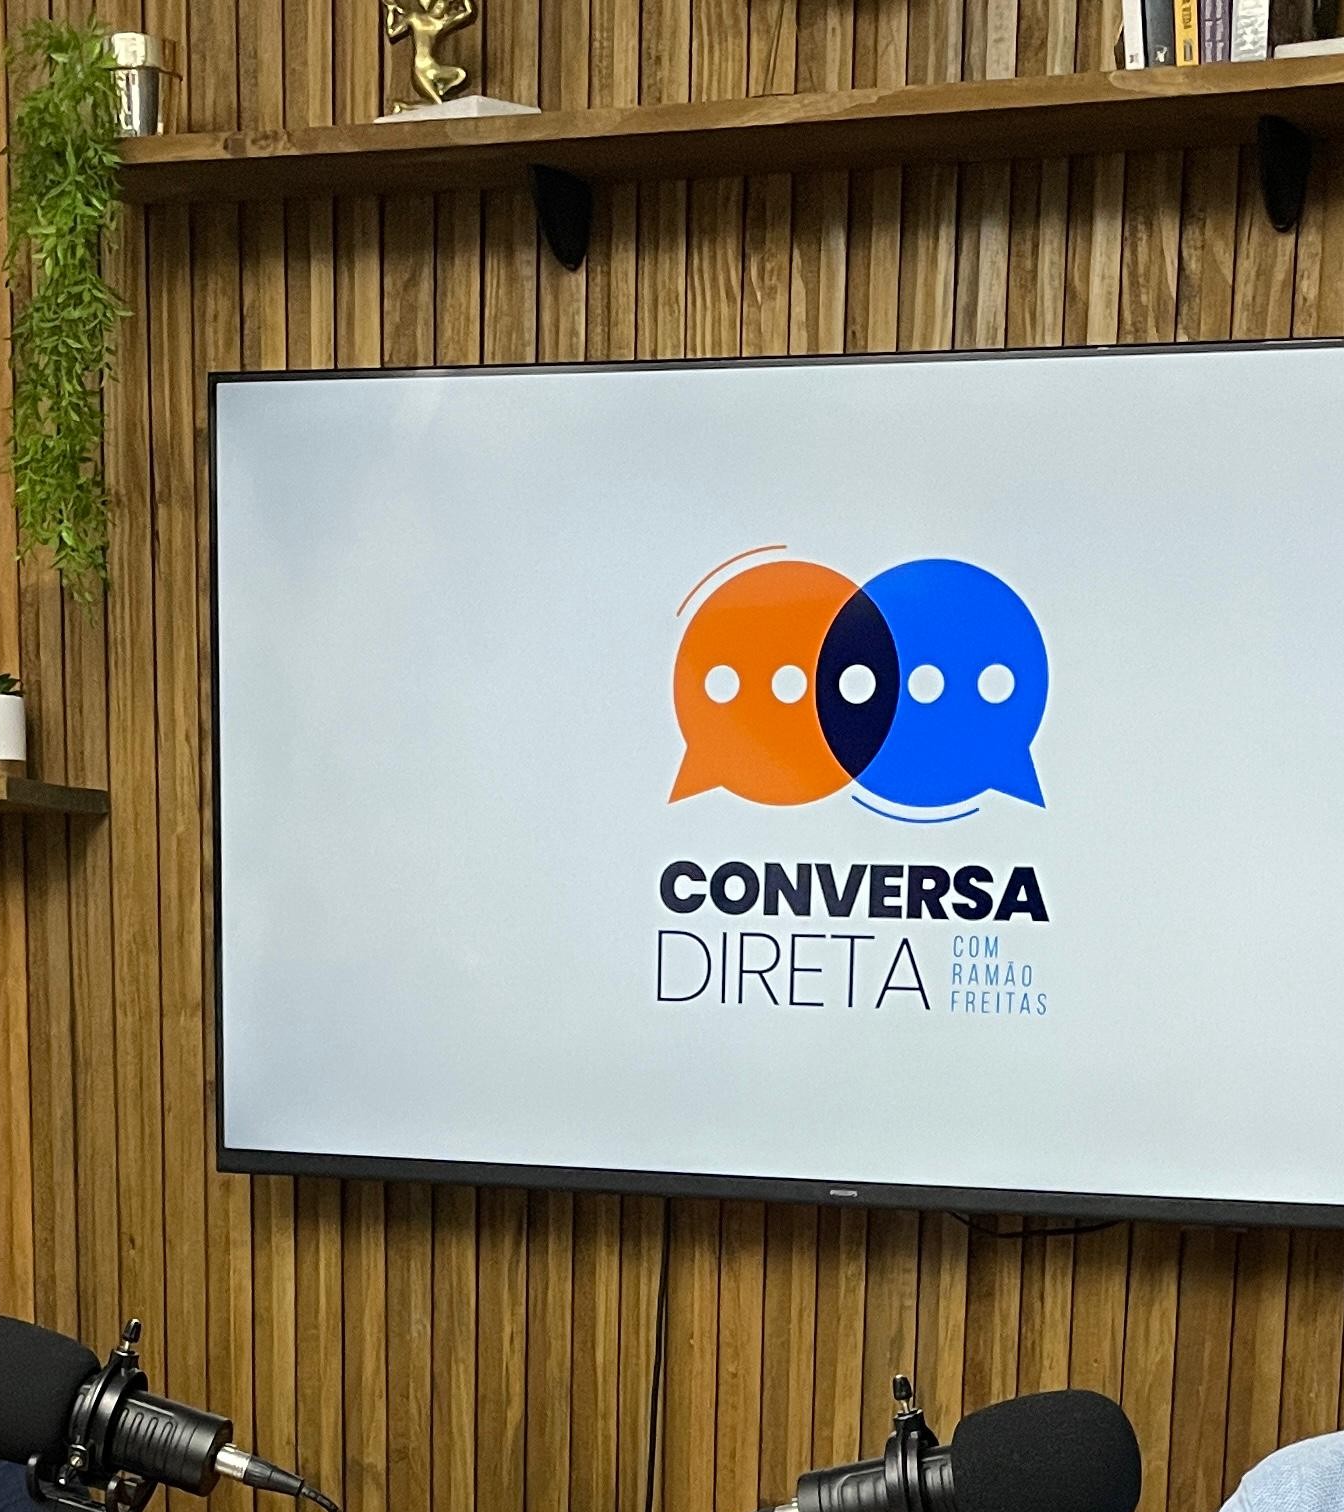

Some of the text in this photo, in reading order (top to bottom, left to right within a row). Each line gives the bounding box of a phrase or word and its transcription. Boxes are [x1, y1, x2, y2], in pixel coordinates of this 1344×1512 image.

[659, 860, 1050, 923] CONVERSA
[953, 935, 1000, 959] COM
[656, 930, 931, 1011] DIRETA
[951, 961, 1034, 988] RAMÃO
[950, 991, 1048, 1016] FREITAS
